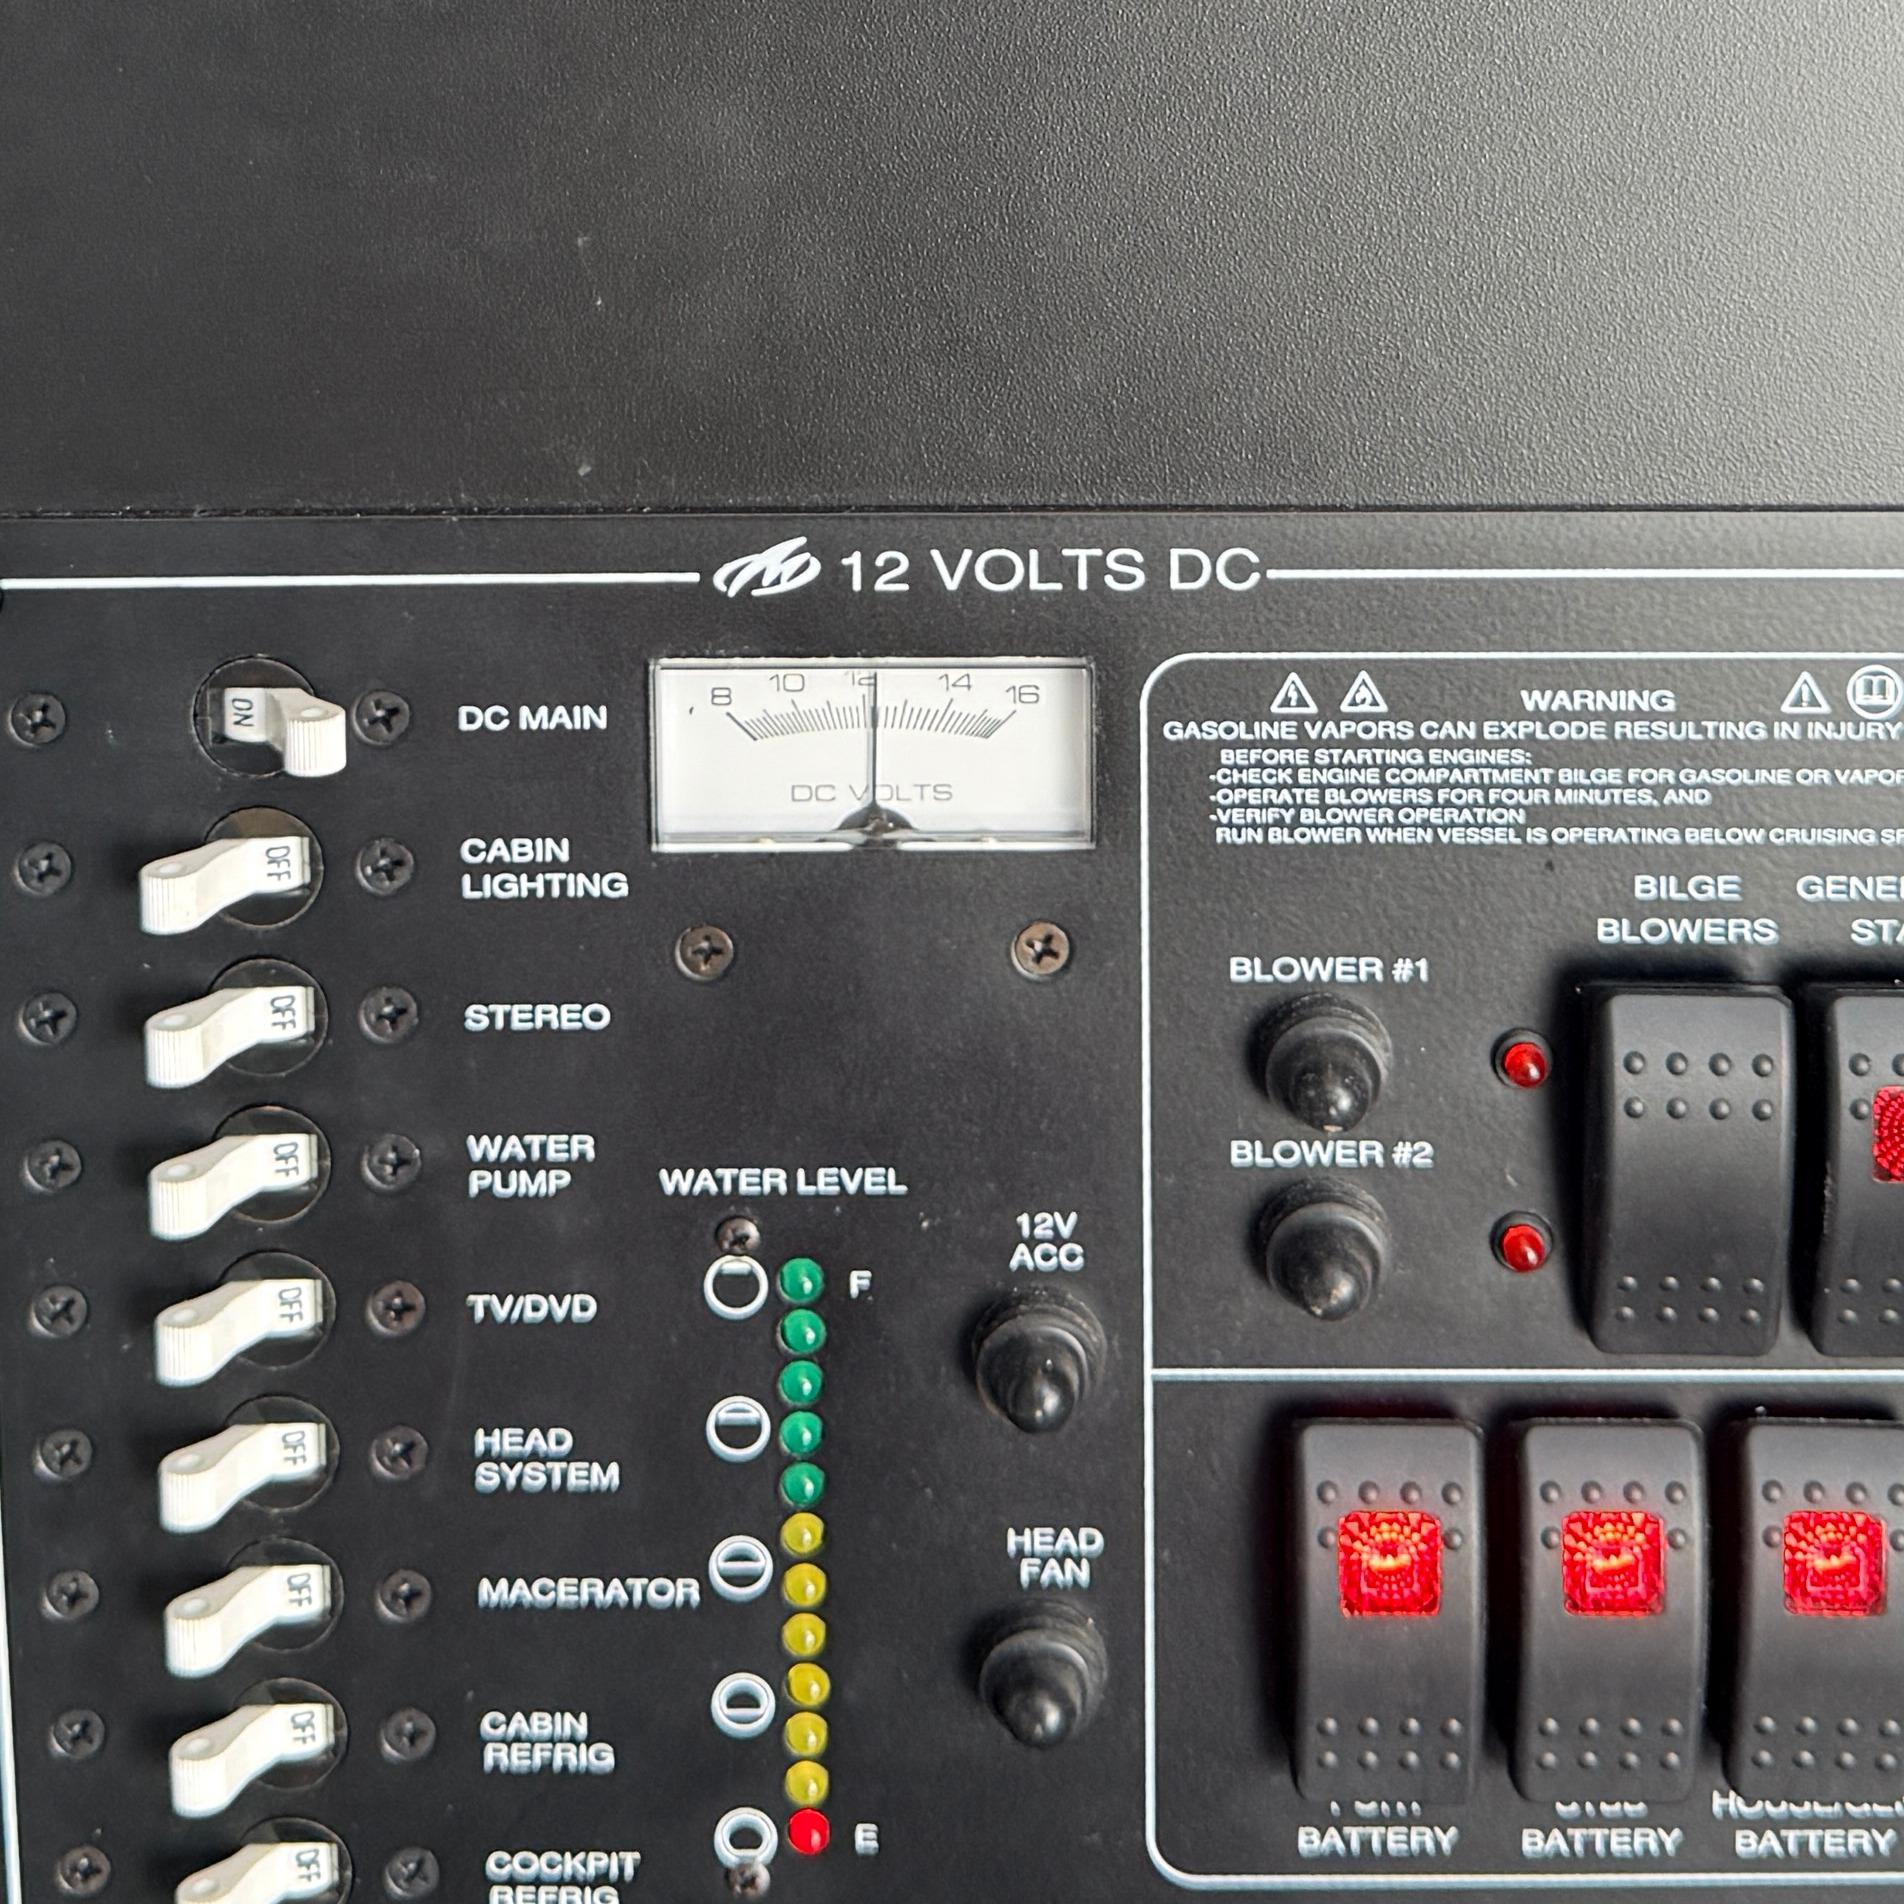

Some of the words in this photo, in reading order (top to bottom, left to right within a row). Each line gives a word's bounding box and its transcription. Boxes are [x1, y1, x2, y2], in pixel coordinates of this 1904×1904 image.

[842, 551, 909, 592] 12
[930, 548, 1146, 592] VOLTS
[1169, 548, 1260, 591] DC
[769, 673, 805, 692] 10
[938, 673, 972, 691] 14
[1005, 685, 1040, 704] 16
[711, 687, 732, 706] 8
[1521, 690, 1676, 711] WARNING
[232, 698, 254, 728] ON
[459, 705, 509, 731] DC
[519, 705, 607, 730] MAIN
[1163, 721, 1297, 741] GASOLINE
[1304, 721, 1414, 741] VAPORS
[1420, 721, 1475, 741] CAN
[1484, 721, 1607, 741] EXPLODE
[1615, 721, 1768, 741] RESULTING
[1774, 721, 1799, 741] IN
[1807, 721, 1900, 741] INJURY
[1221, 749, 1309, 766] BEFORE
[1315, 749, 1424, 766] STARTING
[1430, 749, 1532, 766] ENGINES:
[1209, 769, 1293, 785] -CHECK
[1298, 769, 1380, 785] ENGINE
[1386, 769, 1554, 785] COMPARTMENT
[1559, 769, 1623, 785] BILGE
[1628, 769, 1675, 785] FOR
[1680, 769, 1791, 785] GASOLINE
[1797, 769, 1832, 785] OR
[792, 785, 836, 802] DC
[1209, 788, 1320, 805] -OPERATE
[1325, 788, 1433, 805] BLOWERS
[1438, 788, 1484, 805] FOR
[1488, 788, 1550, 805] FOUR
[1556, 788, 1658, 805] MINUTES,
[1664, 788, 1712, 805] AND
[1209, 808, 1294, 825] -VERIFY
[1300, 808, 1393, 825] BLOWER
[1399, 808, 1525, 825] OPERATION
[1216, 827, 1263, 844] RUN
[1268, 827, 1361, 844] BLOWER
[1366, 827, 1433, 844] WHEN
[1438, 827, 1521, 844] VESSEL
[1527, 827, 1547, 844] IS
[1551, 827, 1680, 844] OPERATING
[1685, 827, 1765, 844] BELOW
[1769, 827, 1876, 844] CRUISING
[265, 845, 291, 883] OFF
[461, 837, 570, 864] CABIN
[461, 873, 629, 899] LIGHTING
[1633, 876, 1742, 901] BILGE
[1596, 917, 1779, 945] BLOWERS
[1229, 958, 1384, 983] BLOWER
[1391, 958, 1428, 983] #1
[463, 1004, 611, 1031] STEREO
[467, 1134, 596, 1162] WATER
[1230, 1141, 1384, 1168] BLOWER
[1392, 1141, 1433, 1167] #2
[468, 1170, 572, 1198] PUMP
[660, 1168, 788, 1195] WATER
[797, 1168, 907, 1195] LEVEL
[1016, 1212, 1078, 1239] 12V
[1010, 1243, 1084, 1270] ACC
[850, 1271, 872, 1297] F
[467, 1295, 597, 1323] TV/DVD
[475, 1428, 573, 1456] HEAD
[475, 1462, 620, 1493] SYSTEM
[1007, 1528, 1104, 1556] HEAD
[1019, 1558, 1091, 1588] FAN
[478, 1579, 700, 1608] MACERATOR
[480, 1712, 588, 1740] CABIN
[483, 1742, 615, 1773] REFRIG
[854, 1823, 879, 1854] E
[1298, 1827, 1459, 1857] BATTERY
[1522, 1828, 1683, 1858] BATTERY
[1735, 1828, 1896, 1859] BATTERY
[485, 1851, 641, 1883] COCKPIT
